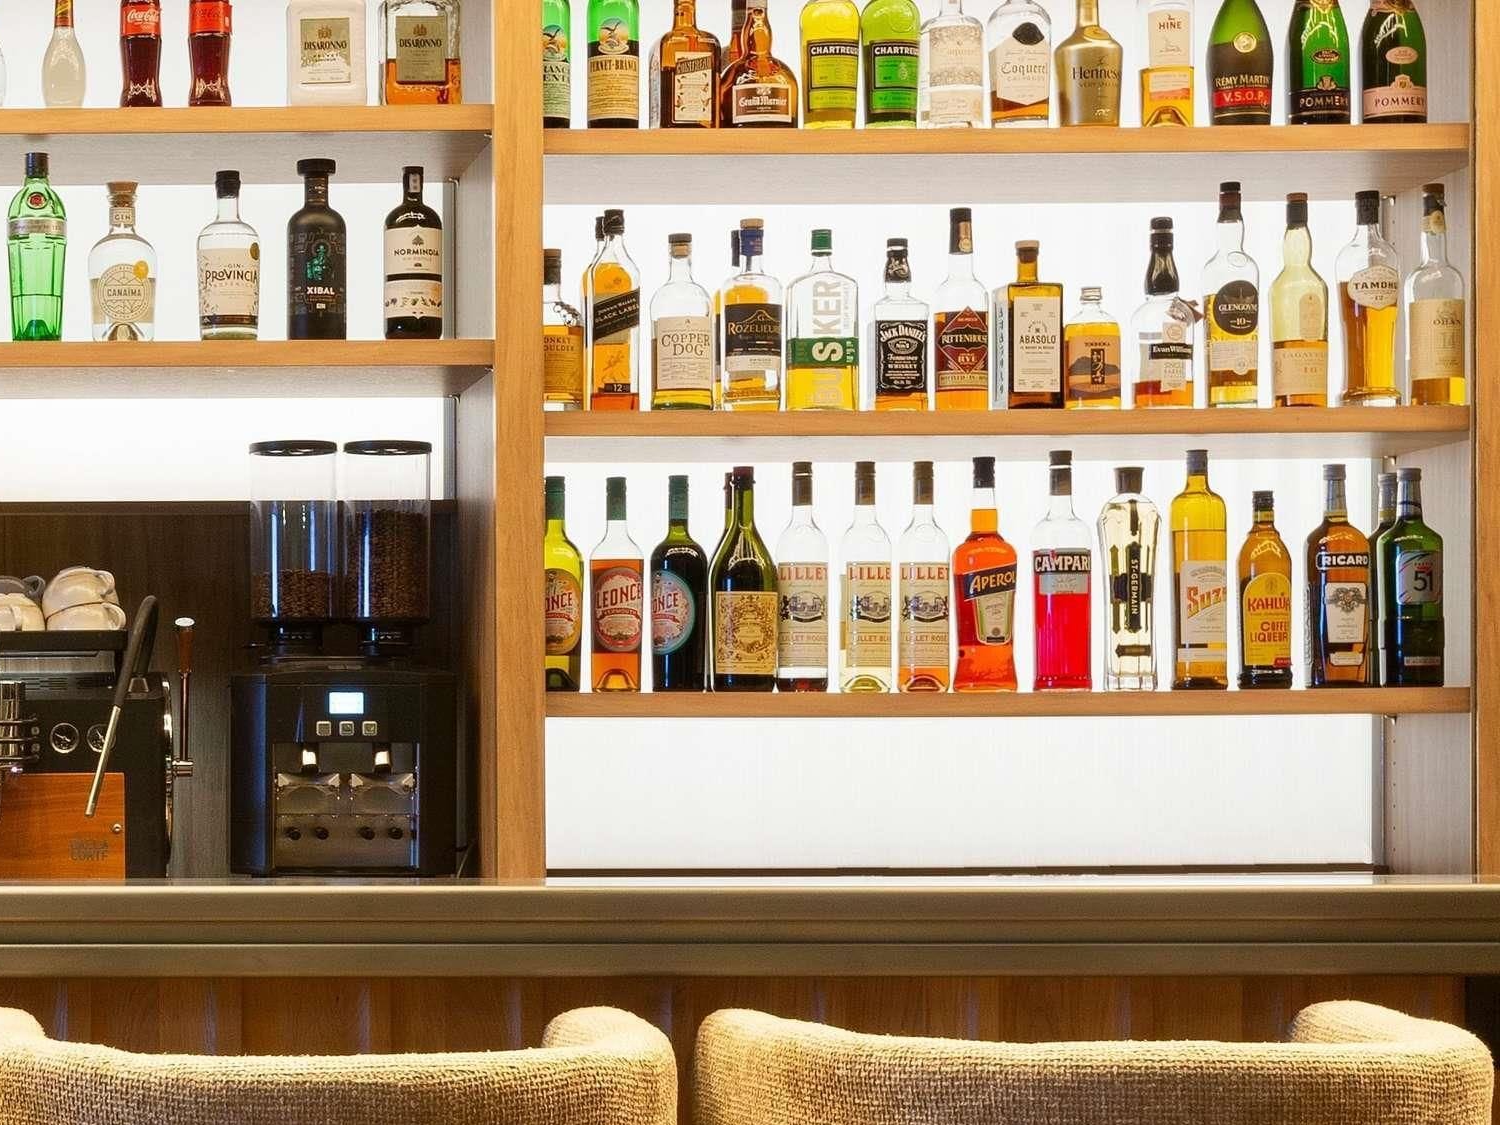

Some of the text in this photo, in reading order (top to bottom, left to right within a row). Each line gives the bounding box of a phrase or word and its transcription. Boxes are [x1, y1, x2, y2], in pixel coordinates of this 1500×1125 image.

[1158, 22, 1182, 30] HINE
[303, 41, 347, 51] DISARONNO
[399, 38, 442, 48] DISARONNO
[394, 248, 440, 257] NORMINDIA
[205, 269, 257, 283] PROVINCIA
[107, 288, 141, 297] CANAIMA
[307, 286, 335, 295] XIBAL
[880, 326, 897, 343] JACK
[1019, 335, 1057, 344] ABASOLO
[544, 336, 571, 344] ONKEY
[661, 333, 710, 347] COPPER
[673, 343, 704, 356] DOG
[1153, 345, 1169, 353] Evan
[613, 384, 622, 392] 12
[1321, 555, 1368, 567] RICARD
[849, 567, 891, 580] LILLE
[969, 571, 1015, 593] APEROL
[1413, 570, 1434, 591] 51
[596, 583, 641, 609] LEONCE
